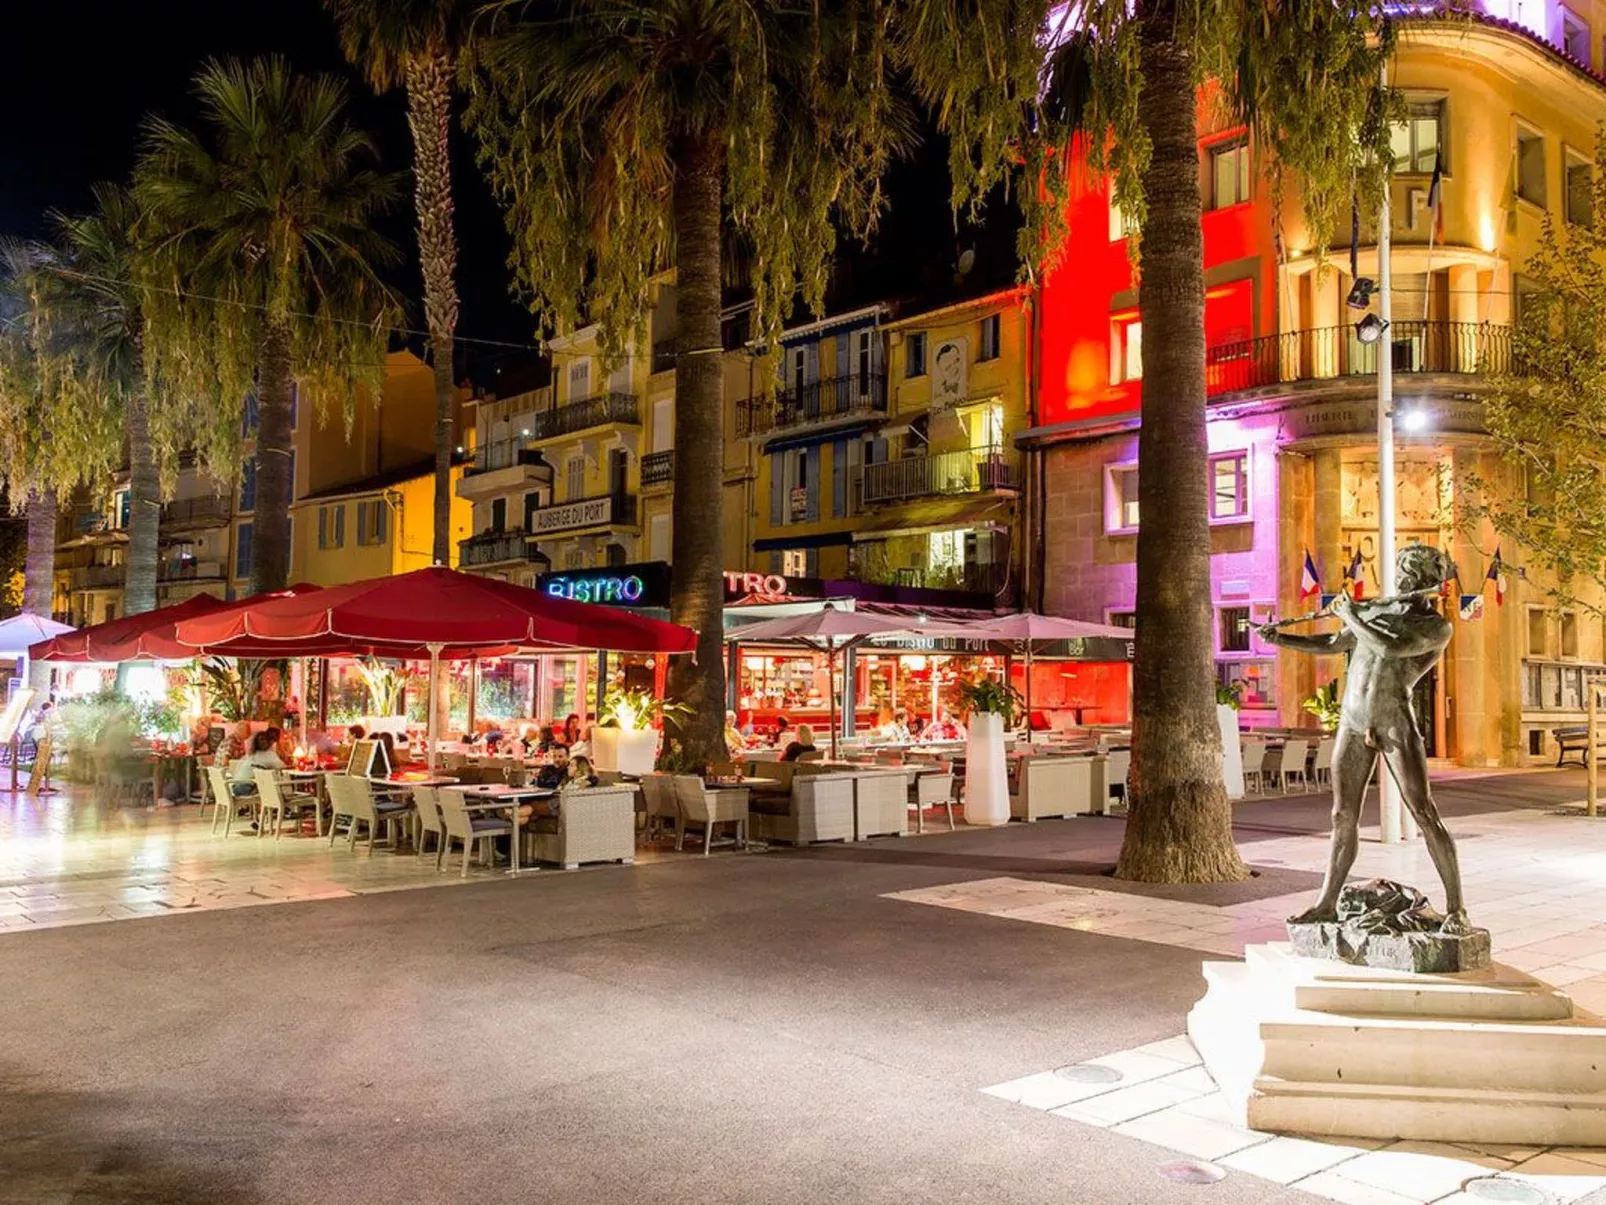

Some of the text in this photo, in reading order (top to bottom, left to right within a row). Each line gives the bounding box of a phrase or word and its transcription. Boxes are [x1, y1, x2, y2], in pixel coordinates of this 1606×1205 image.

[537, 503, 604, 529] AUBERGE DU PORT
[549, 575, 643, 603] BISTRO
[722, 571, 787, 596] TRO
